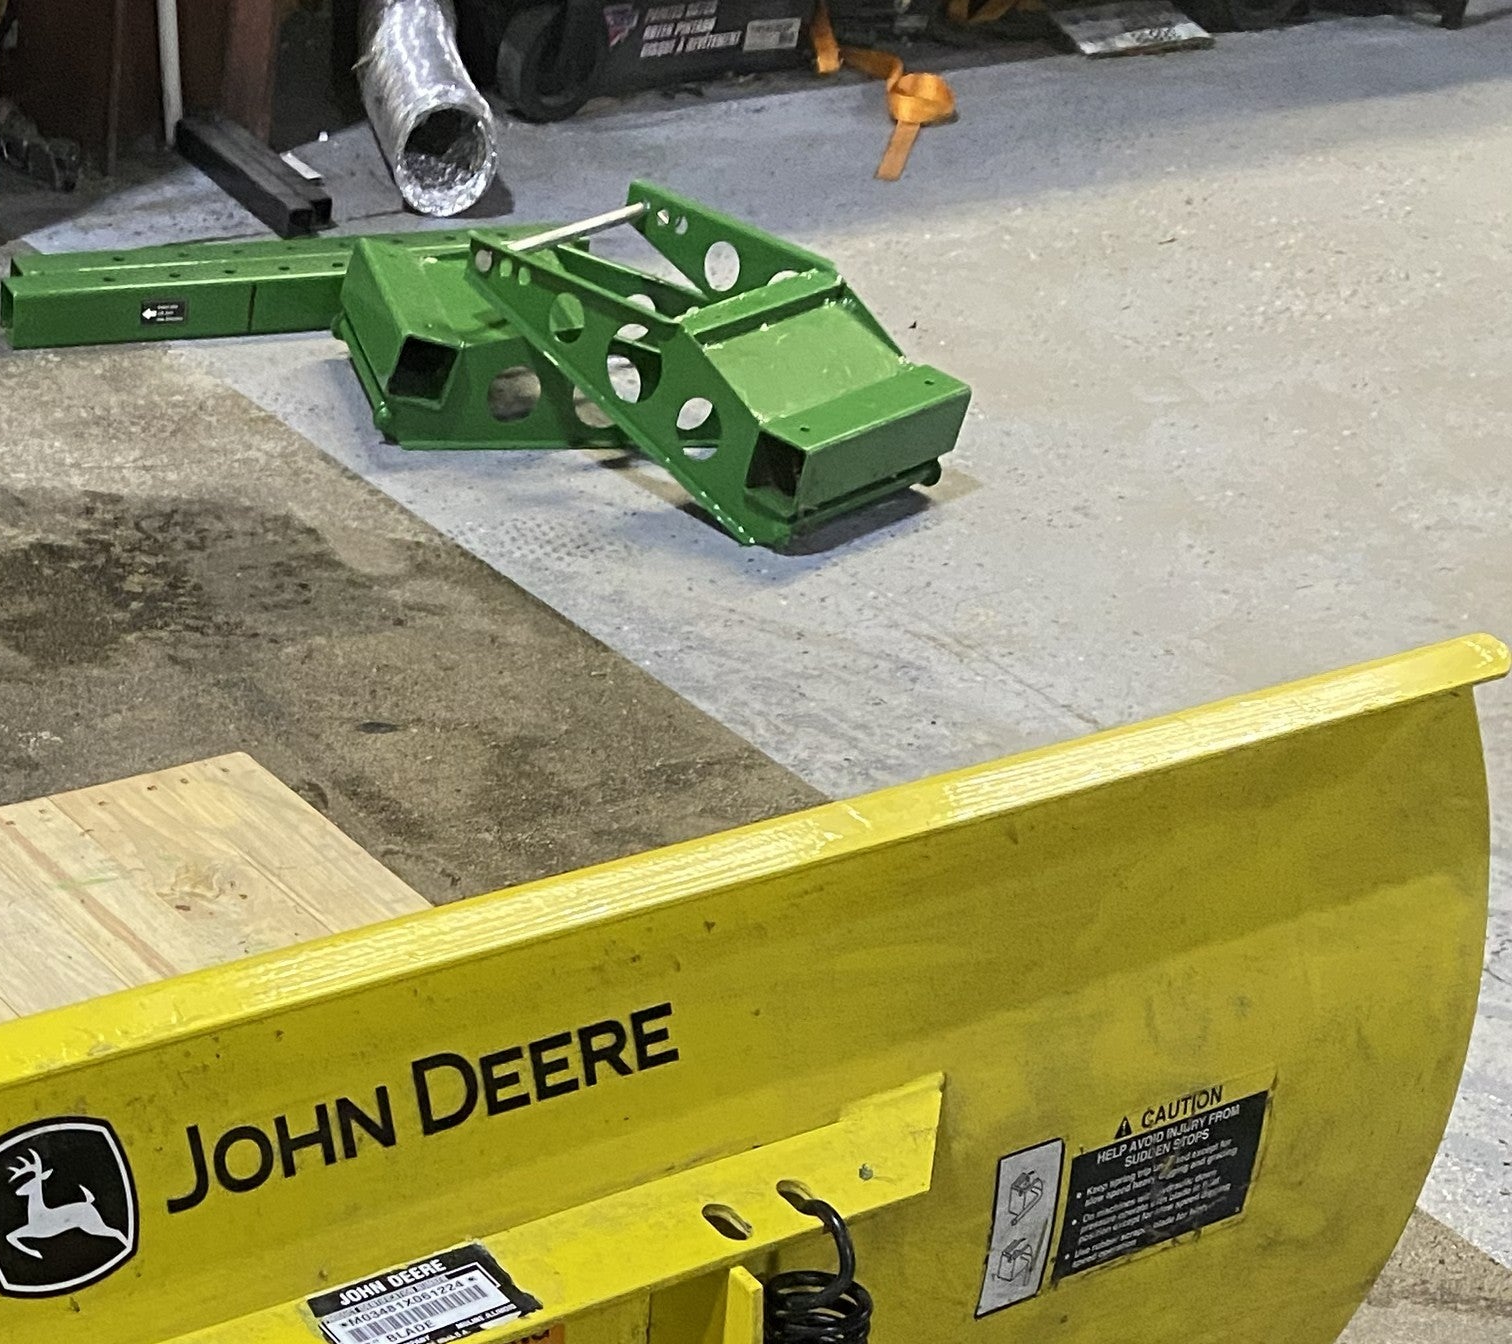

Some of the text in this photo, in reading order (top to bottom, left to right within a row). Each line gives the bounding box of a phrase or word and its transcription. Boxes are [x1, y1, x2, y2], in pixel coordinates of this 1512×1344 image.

[167, 1001, 681, 1214] JOHN DEERE
[1141, 1085, 1224, 1129] CAUTION
[1097, 1144, 1128, 1165] HELP
[1129, 1131, 1164, 1153] AVOID
[1166, 1115, 1207, 1139] INJURY
[1208, 1104, 1240, 1126] FROM
[1173, 1128, 1210, 1151] STOPS
[339, 1280, 388, 1306] JOHN
[388, 1258, 447, 1288] DEERE
[387, 1320, 433, 1343] BLADE
